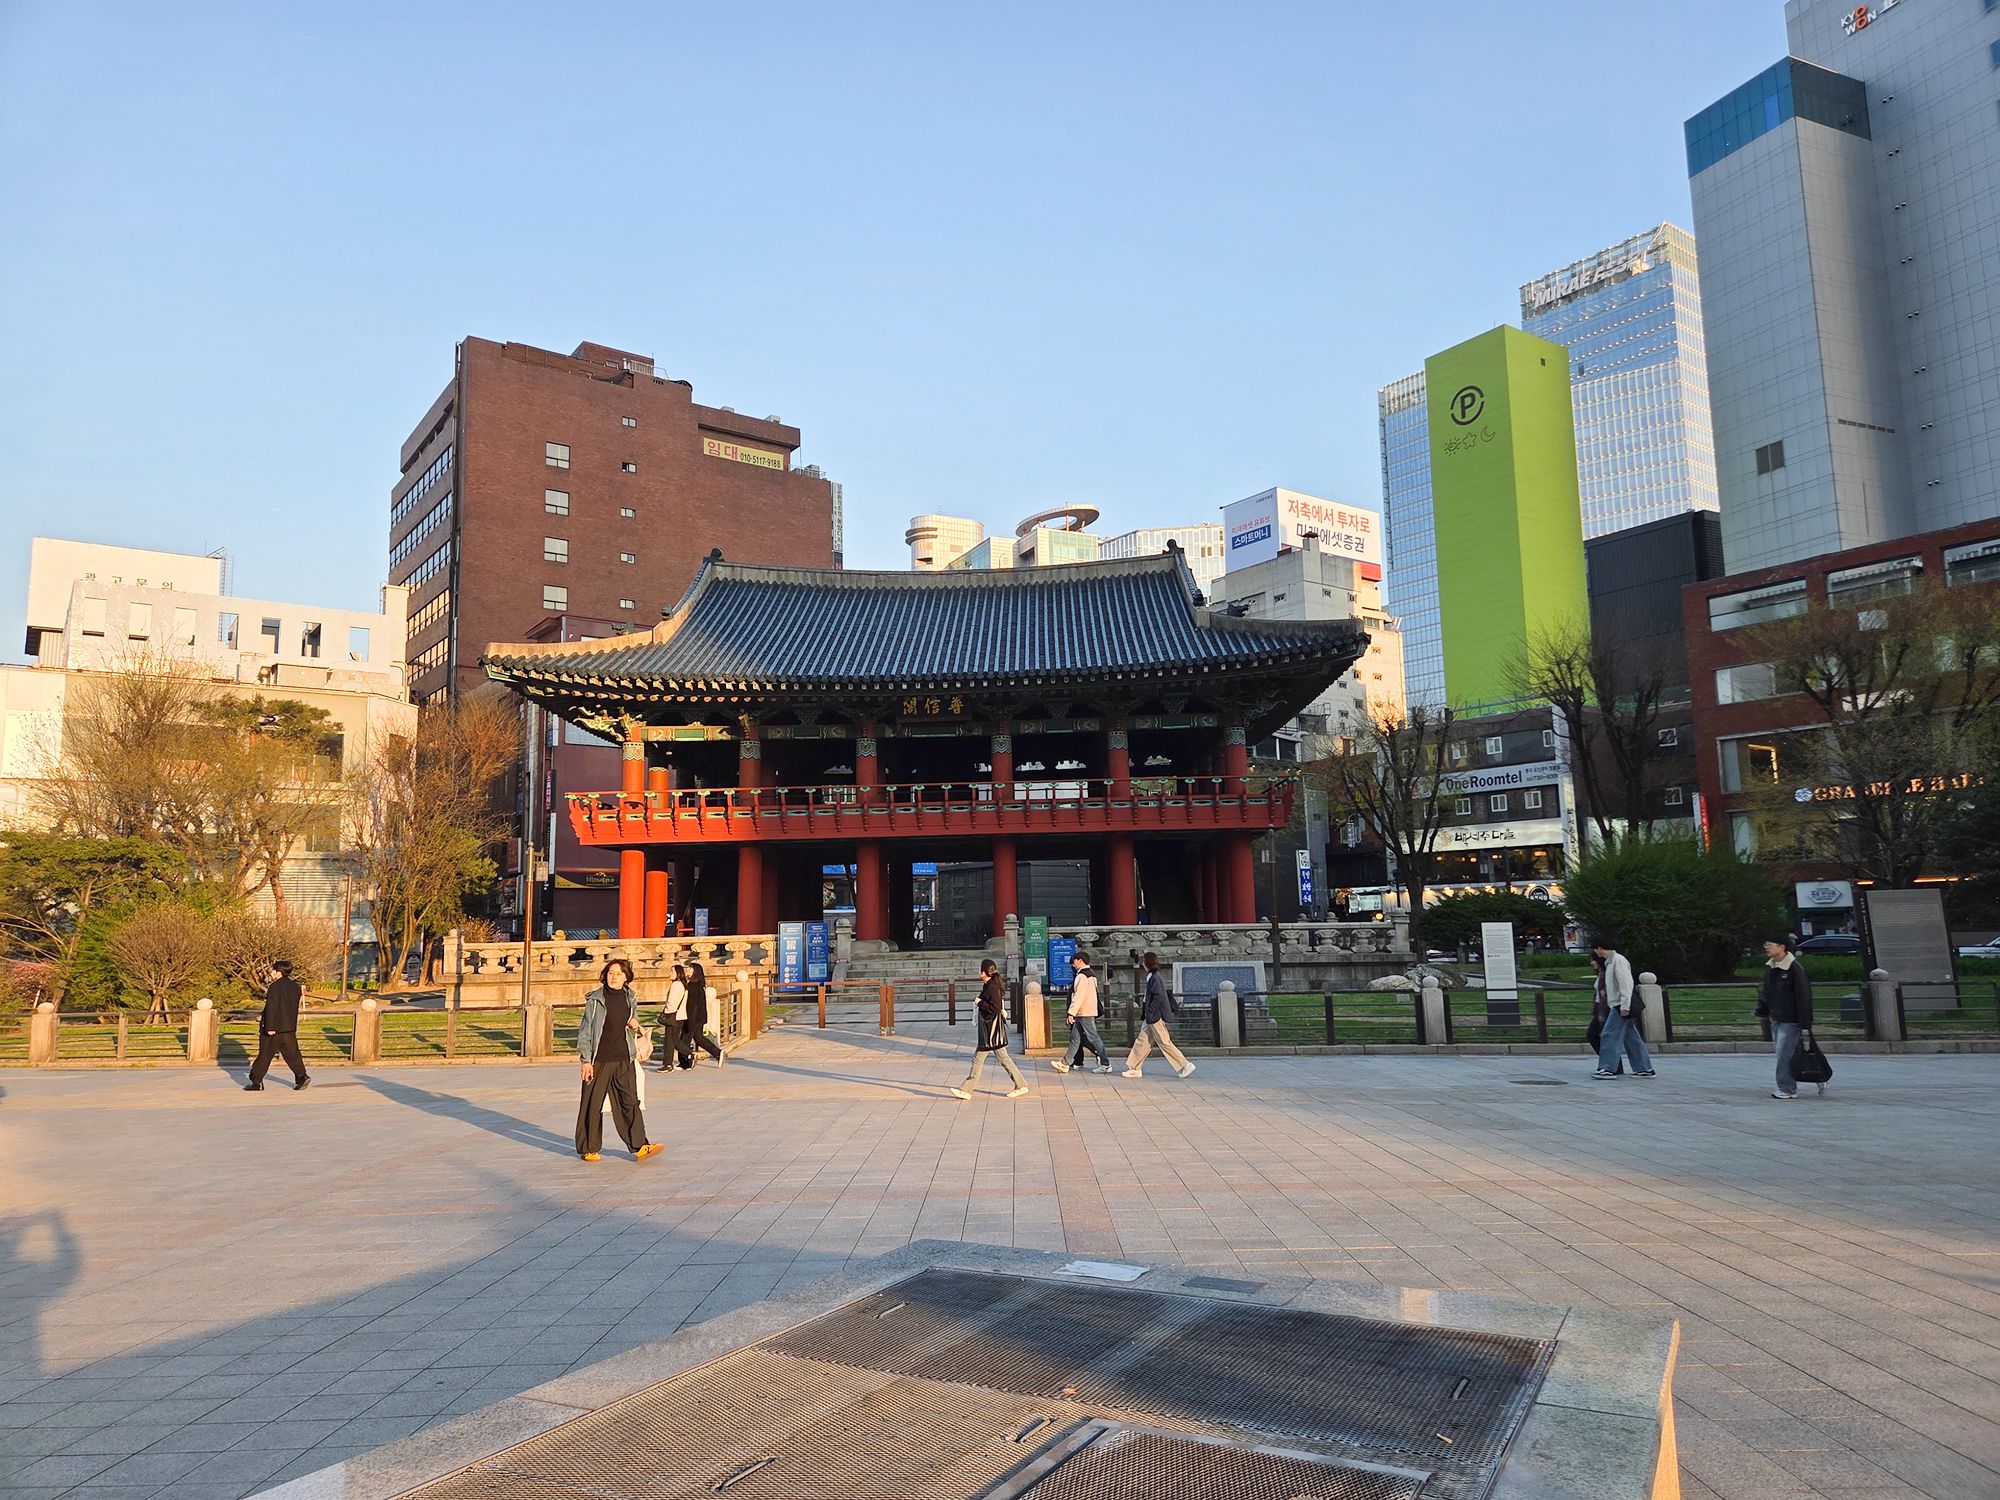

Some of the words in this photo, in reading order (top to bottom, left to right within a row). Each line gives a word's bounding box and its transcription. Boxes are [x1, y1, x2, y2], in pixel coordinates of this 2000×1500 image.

[1841, 4, 1868, 28] KYO
[1845, 10, 1878, 36] WON
[1534, 270, 1592, 309] MIRAE
[707, 441, 738, 461] 임대
[1288, 499, 1335, 527] 저축에서
[1337, 510, 1371, 534] 투자로
[1233, 526, 1269, 547] 스마트머니
